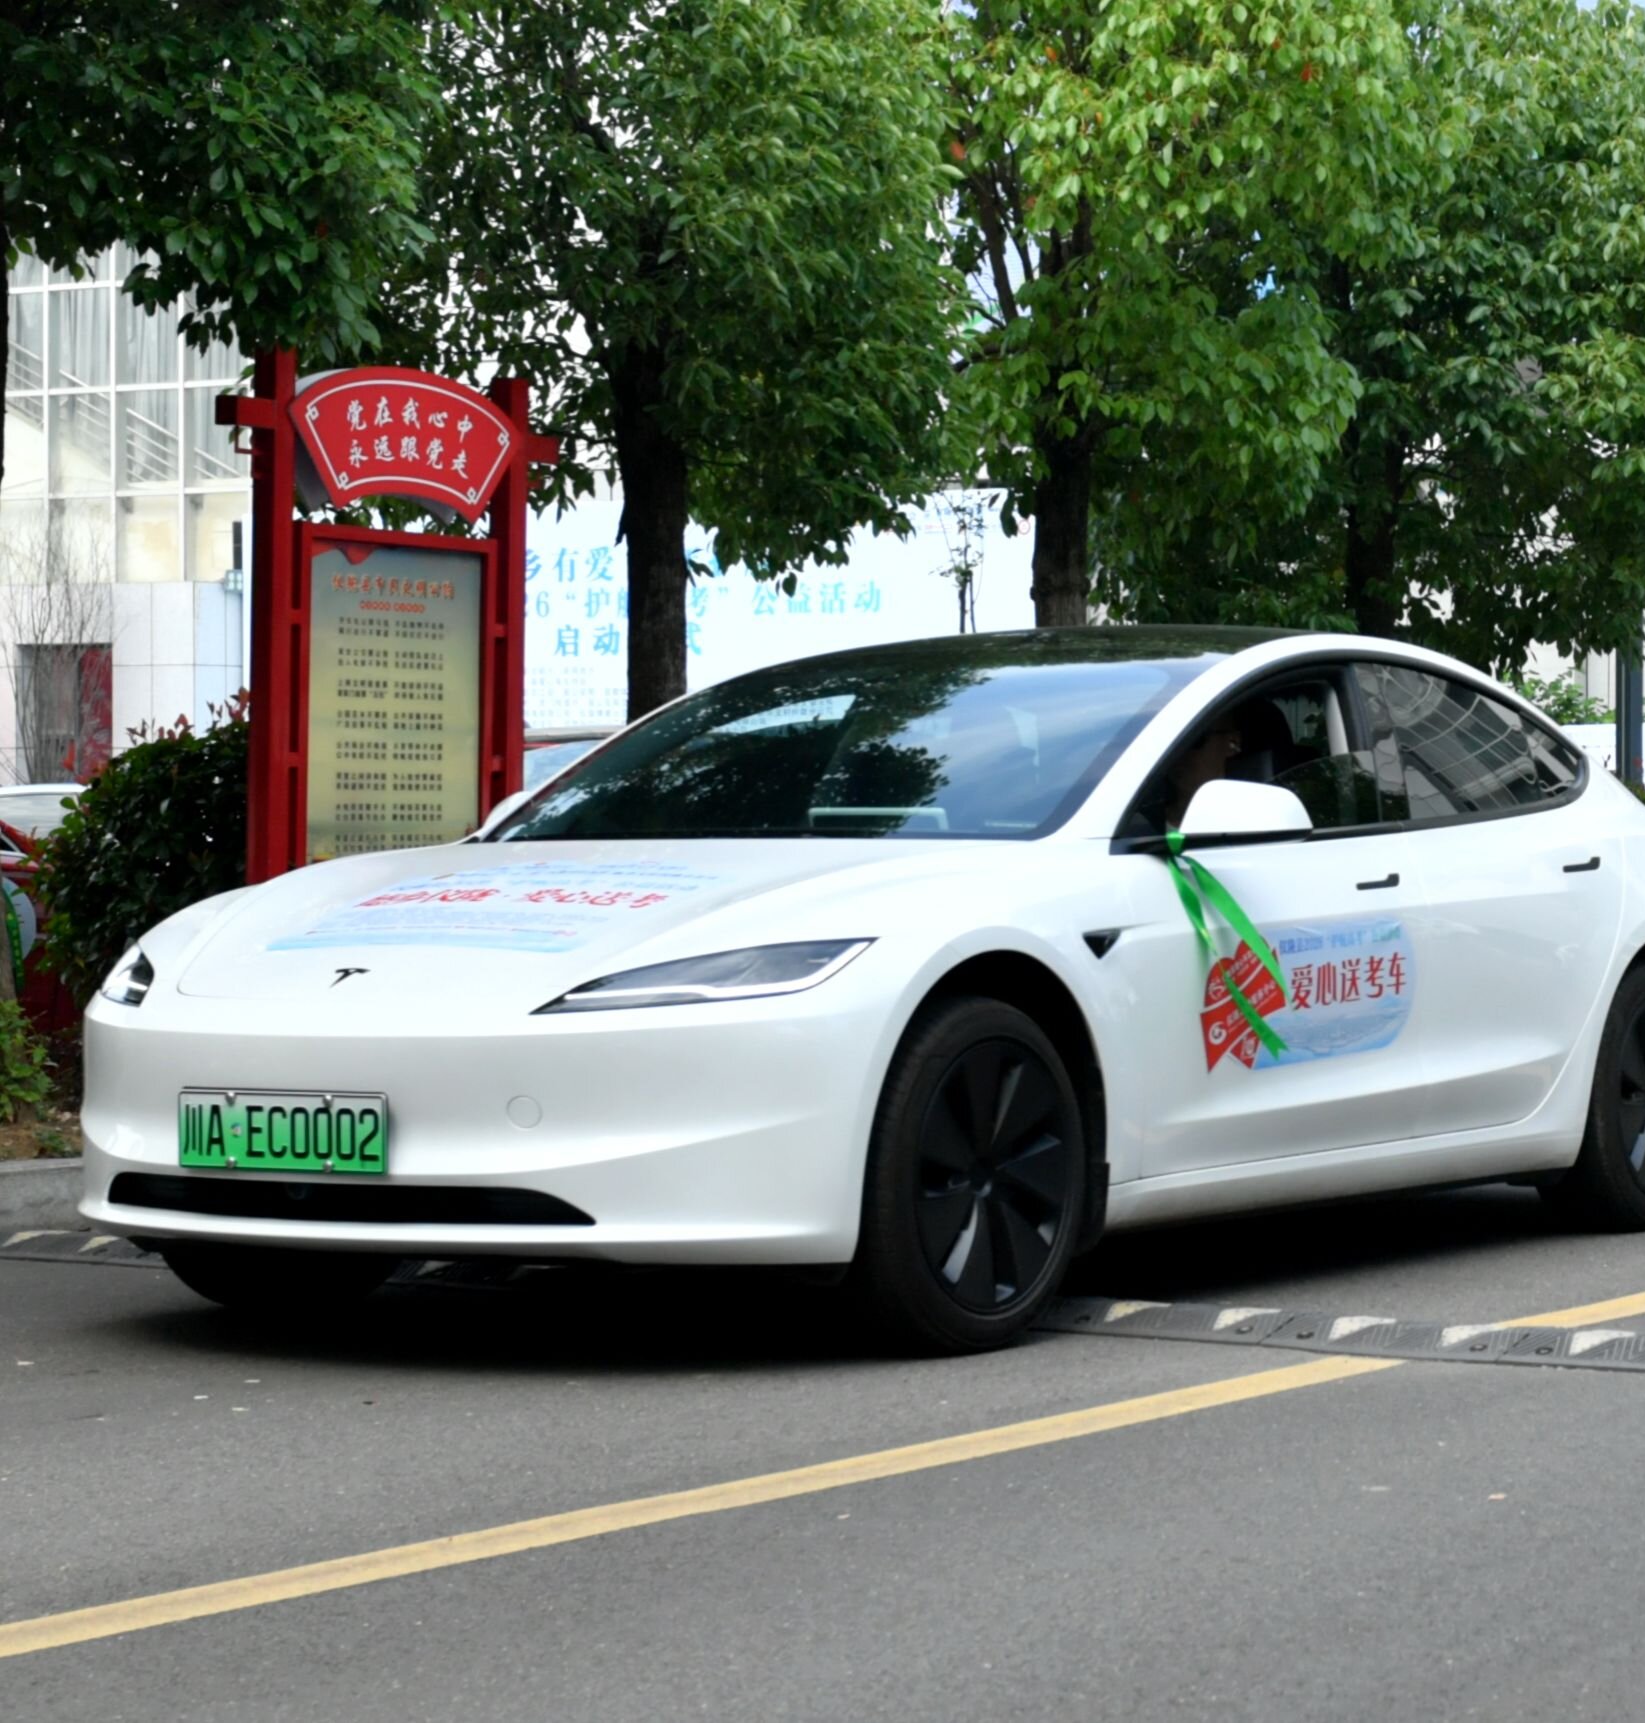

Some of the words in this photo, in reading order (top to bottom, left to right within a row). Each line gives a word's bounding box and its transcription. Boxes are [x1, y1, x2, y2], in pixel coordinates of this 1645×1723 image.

[348, 435, 469, 479] 永远跟党走
[1291, 952, 1407, 1011] 爱心送考车
